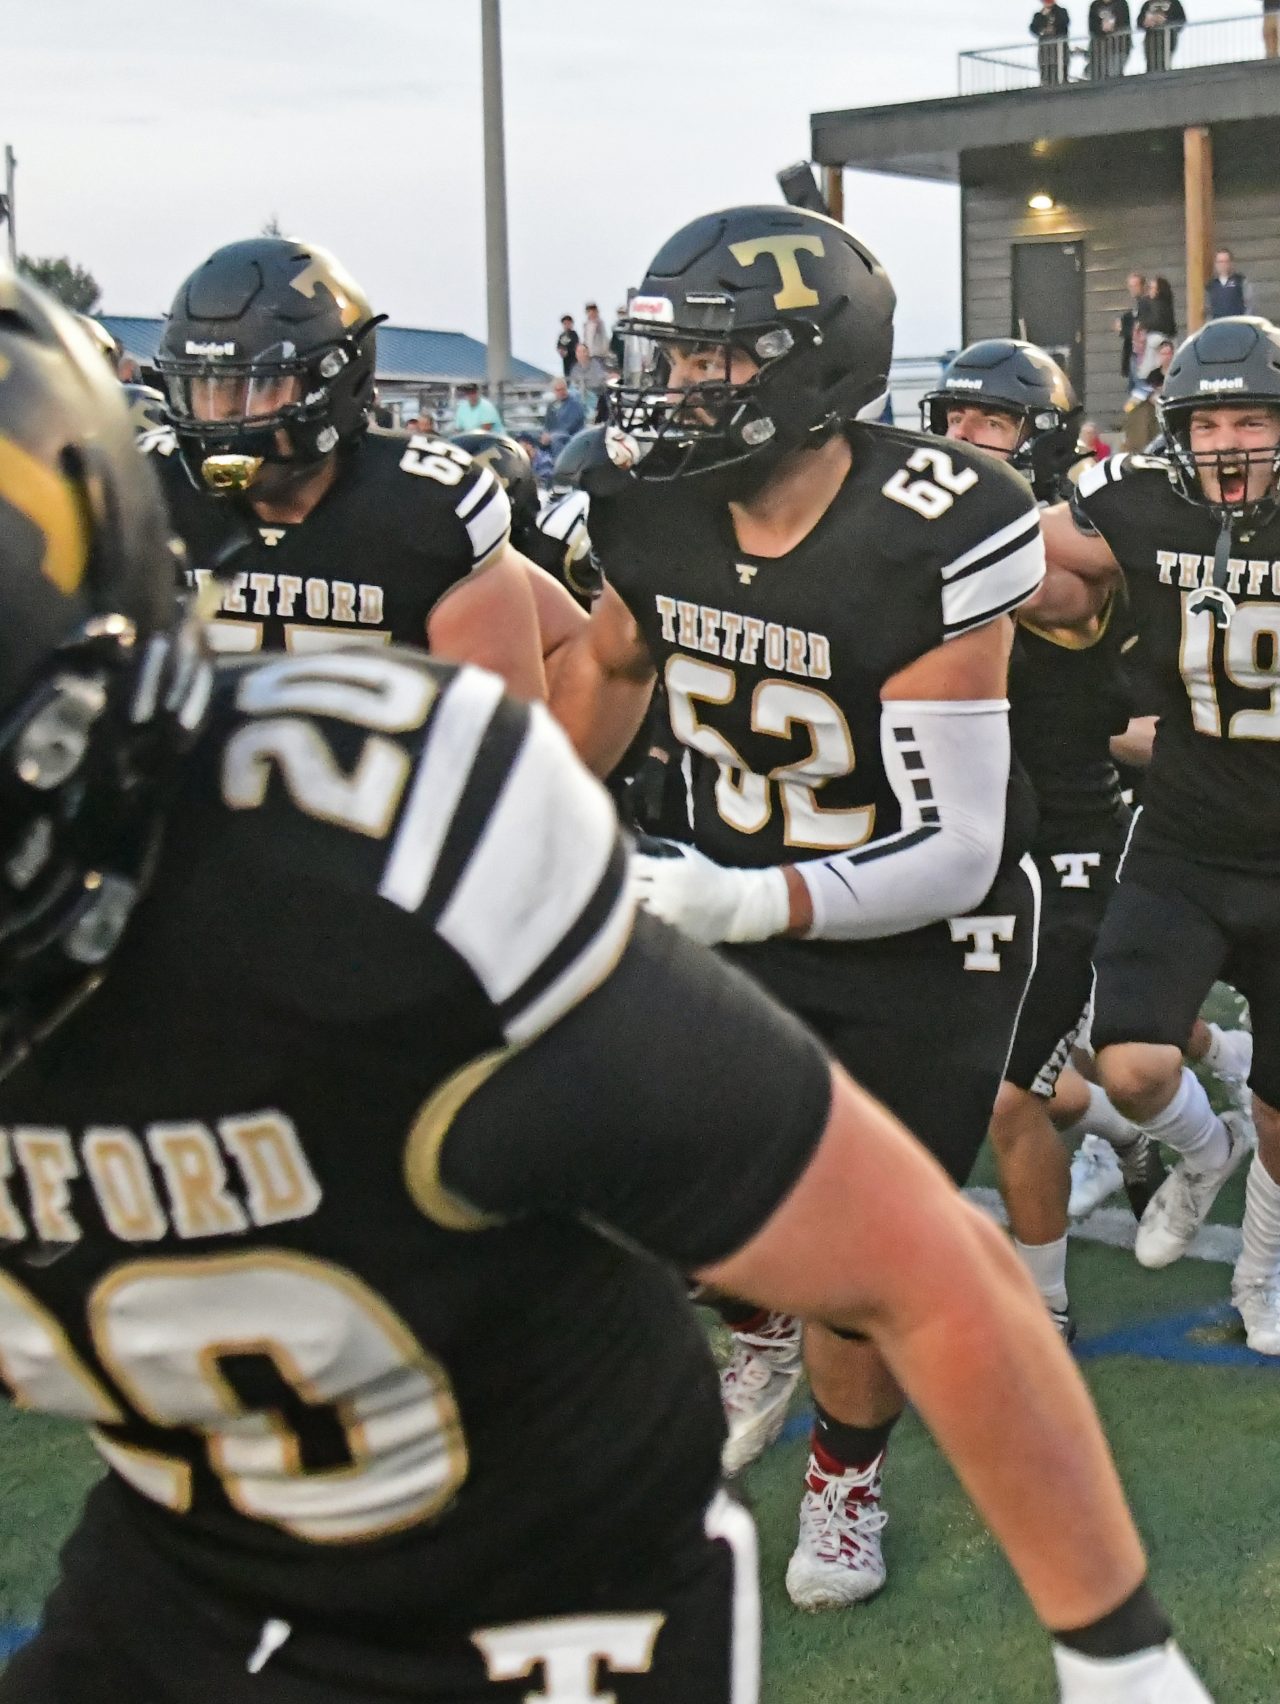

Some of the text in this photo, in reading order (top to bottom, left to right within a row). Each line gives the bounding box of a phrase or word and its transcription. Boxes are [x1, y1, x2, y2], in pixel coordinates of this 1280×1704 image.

[728, 234, 825, 310] T
[1200, 377, 1243, 392] Riddell
[882, 447, 979, 520] 62
[735, 563, 757, 585] T
[655, 595, 832, 681] THETFORD
[222, 651, 440, 840] 20
[1051, 852, 1101, 889] T
[947, 914, 1016, 972] T
[470, 1612, 667, 1704] T
